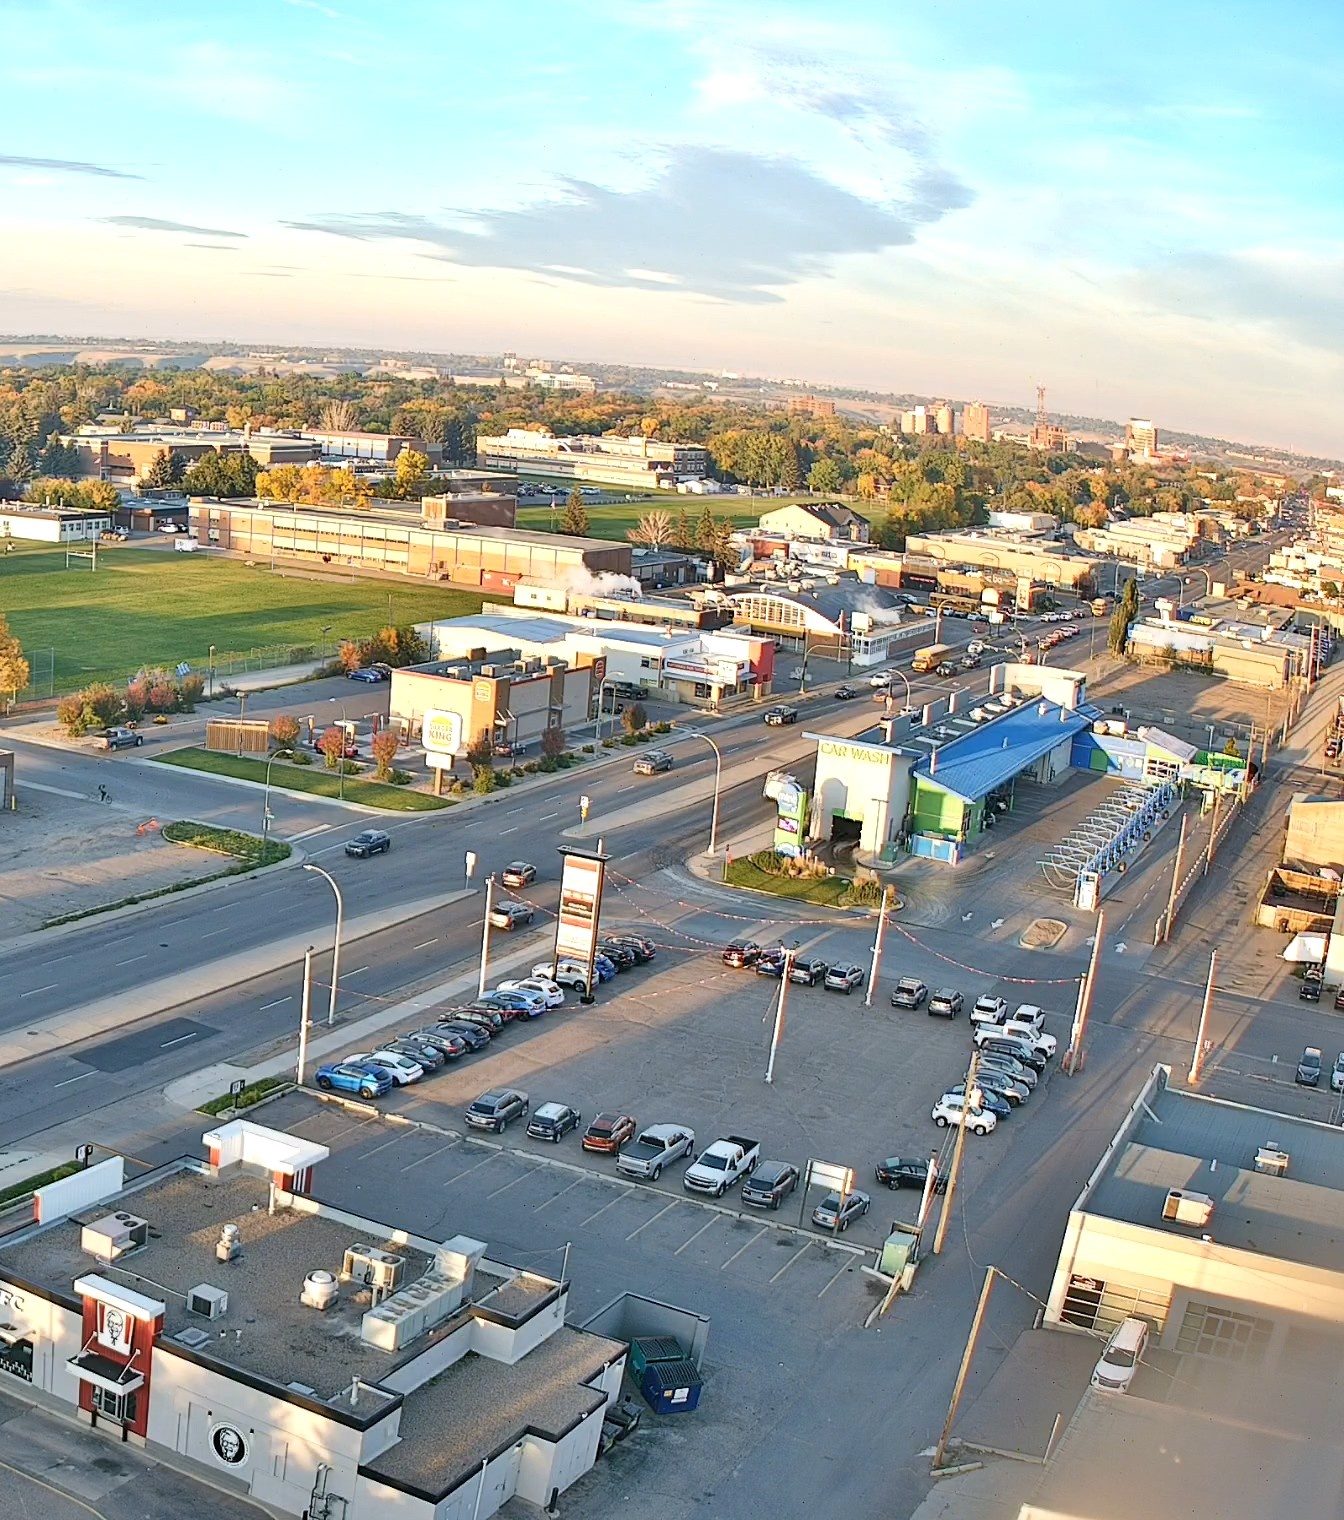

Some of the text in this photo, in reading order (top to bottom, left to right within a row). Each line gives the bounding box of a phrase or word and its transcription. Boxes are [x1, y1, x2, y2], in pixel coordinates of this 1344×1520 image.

[429, 730, 452, 742] KING
[821, 742, 890, 764] CAR WASH
